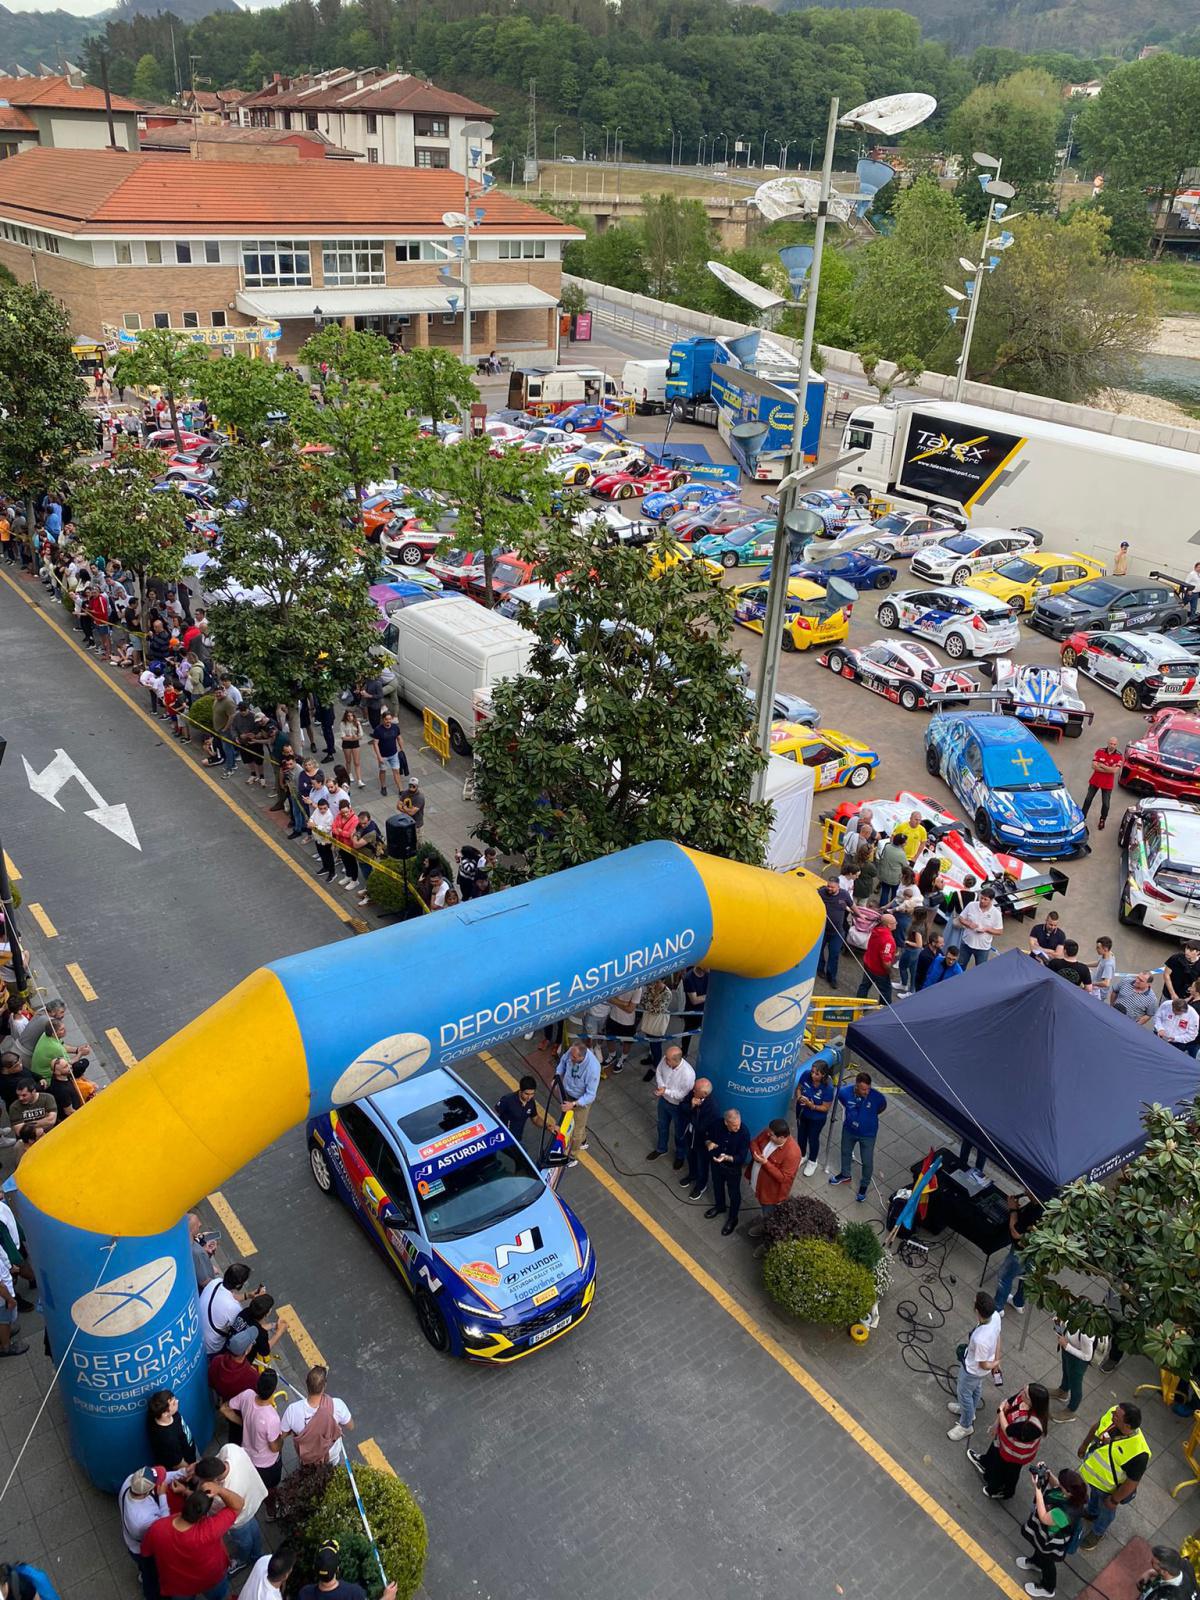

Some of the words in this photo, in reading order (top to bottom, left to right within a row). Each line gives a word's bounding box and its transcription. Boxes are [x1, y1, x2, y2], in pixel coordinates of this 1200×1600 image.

[917, 430, 987, 460] Talex
[439, 981, 562, 1048] DEPORTE
[568, 928, 696, 997] ASTURIANO
[439, 1030, 511, 1064] GOBIERNO
[512, 1020, 534, 1036] DEL
[538, 989, 610, 1023] PRINCIPADO
[610, 982, 626, 995] DE
[631, 957, 688, 988] ASTURIAS
[434, 1129, 472, 1147] SEGURIDAD
[437, 1140, 488, 1169] ASTURDAI
[509, 1277, 533, 1293] ASTURDAI
[533, 1269, 549, 1280] RALLY
[549, 1262, 563, 1272] TEAM
[520, 1252, 558, 1276] HYUNDAI
[72, 1298, 197, 1371] DEPORTE
[76, 1314, 199, 1388] ASTURIANO
[99, 1374, 169, 1402] GOBIERNO
[170, 1357, 188, 1377] DEL
[73, 1396, 148, 1414] PRINCIPADO
